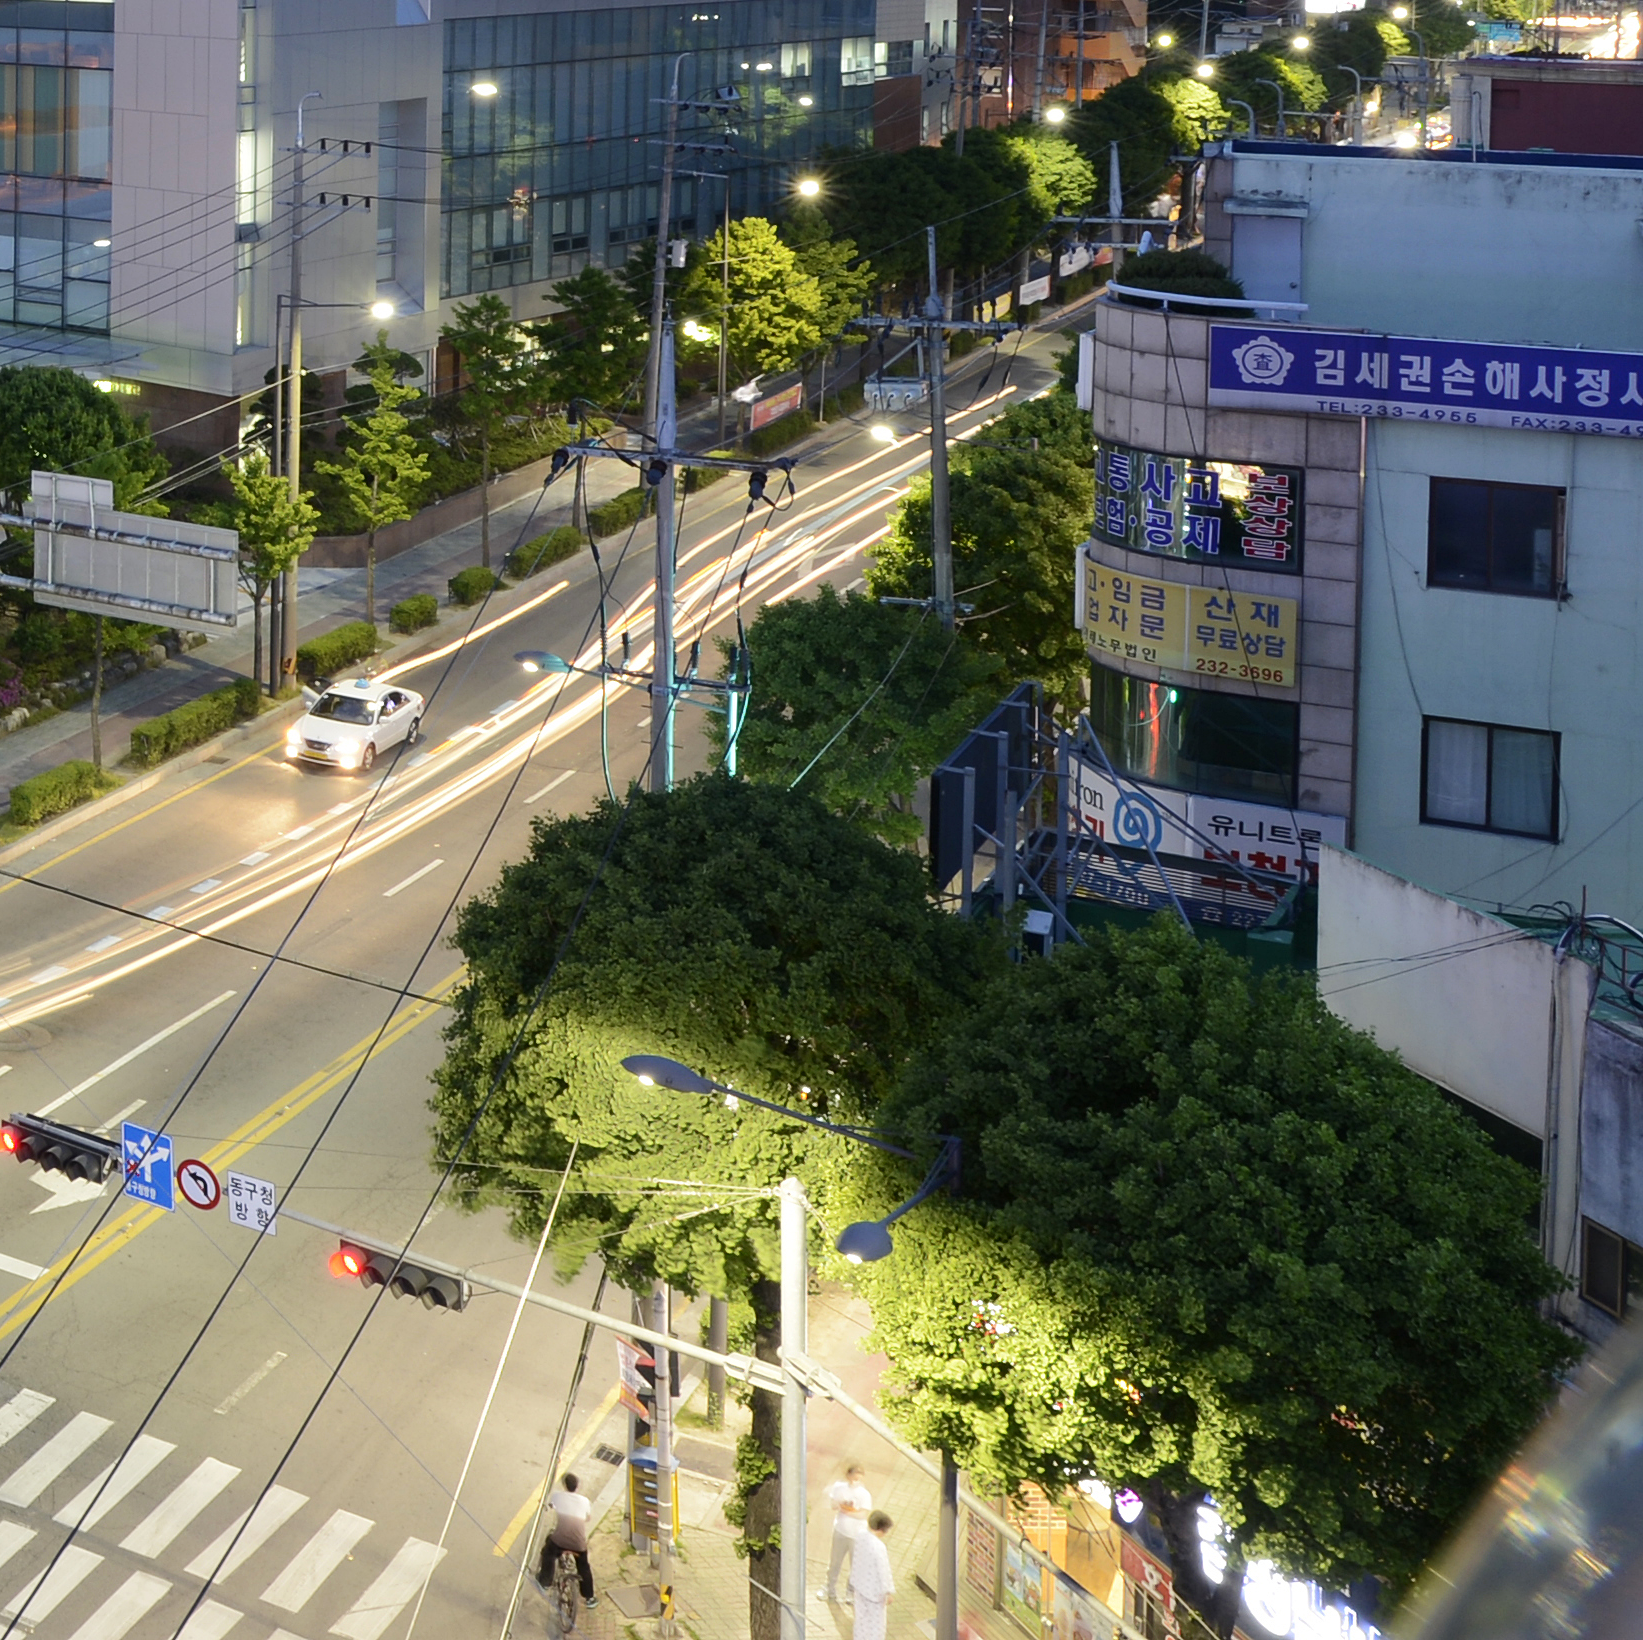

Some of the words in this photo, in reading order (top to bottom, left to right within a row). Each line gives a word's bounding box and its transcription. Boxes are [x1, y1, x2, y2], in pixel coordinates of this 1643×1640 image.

[1317, 400, 1477, 424] TEL:233-4955
[1196, 624, 1286, 659] 무료상담
[1196, 657, 1284, 683] 232-3696
[230, 1176, 273, 1207] 동구청
